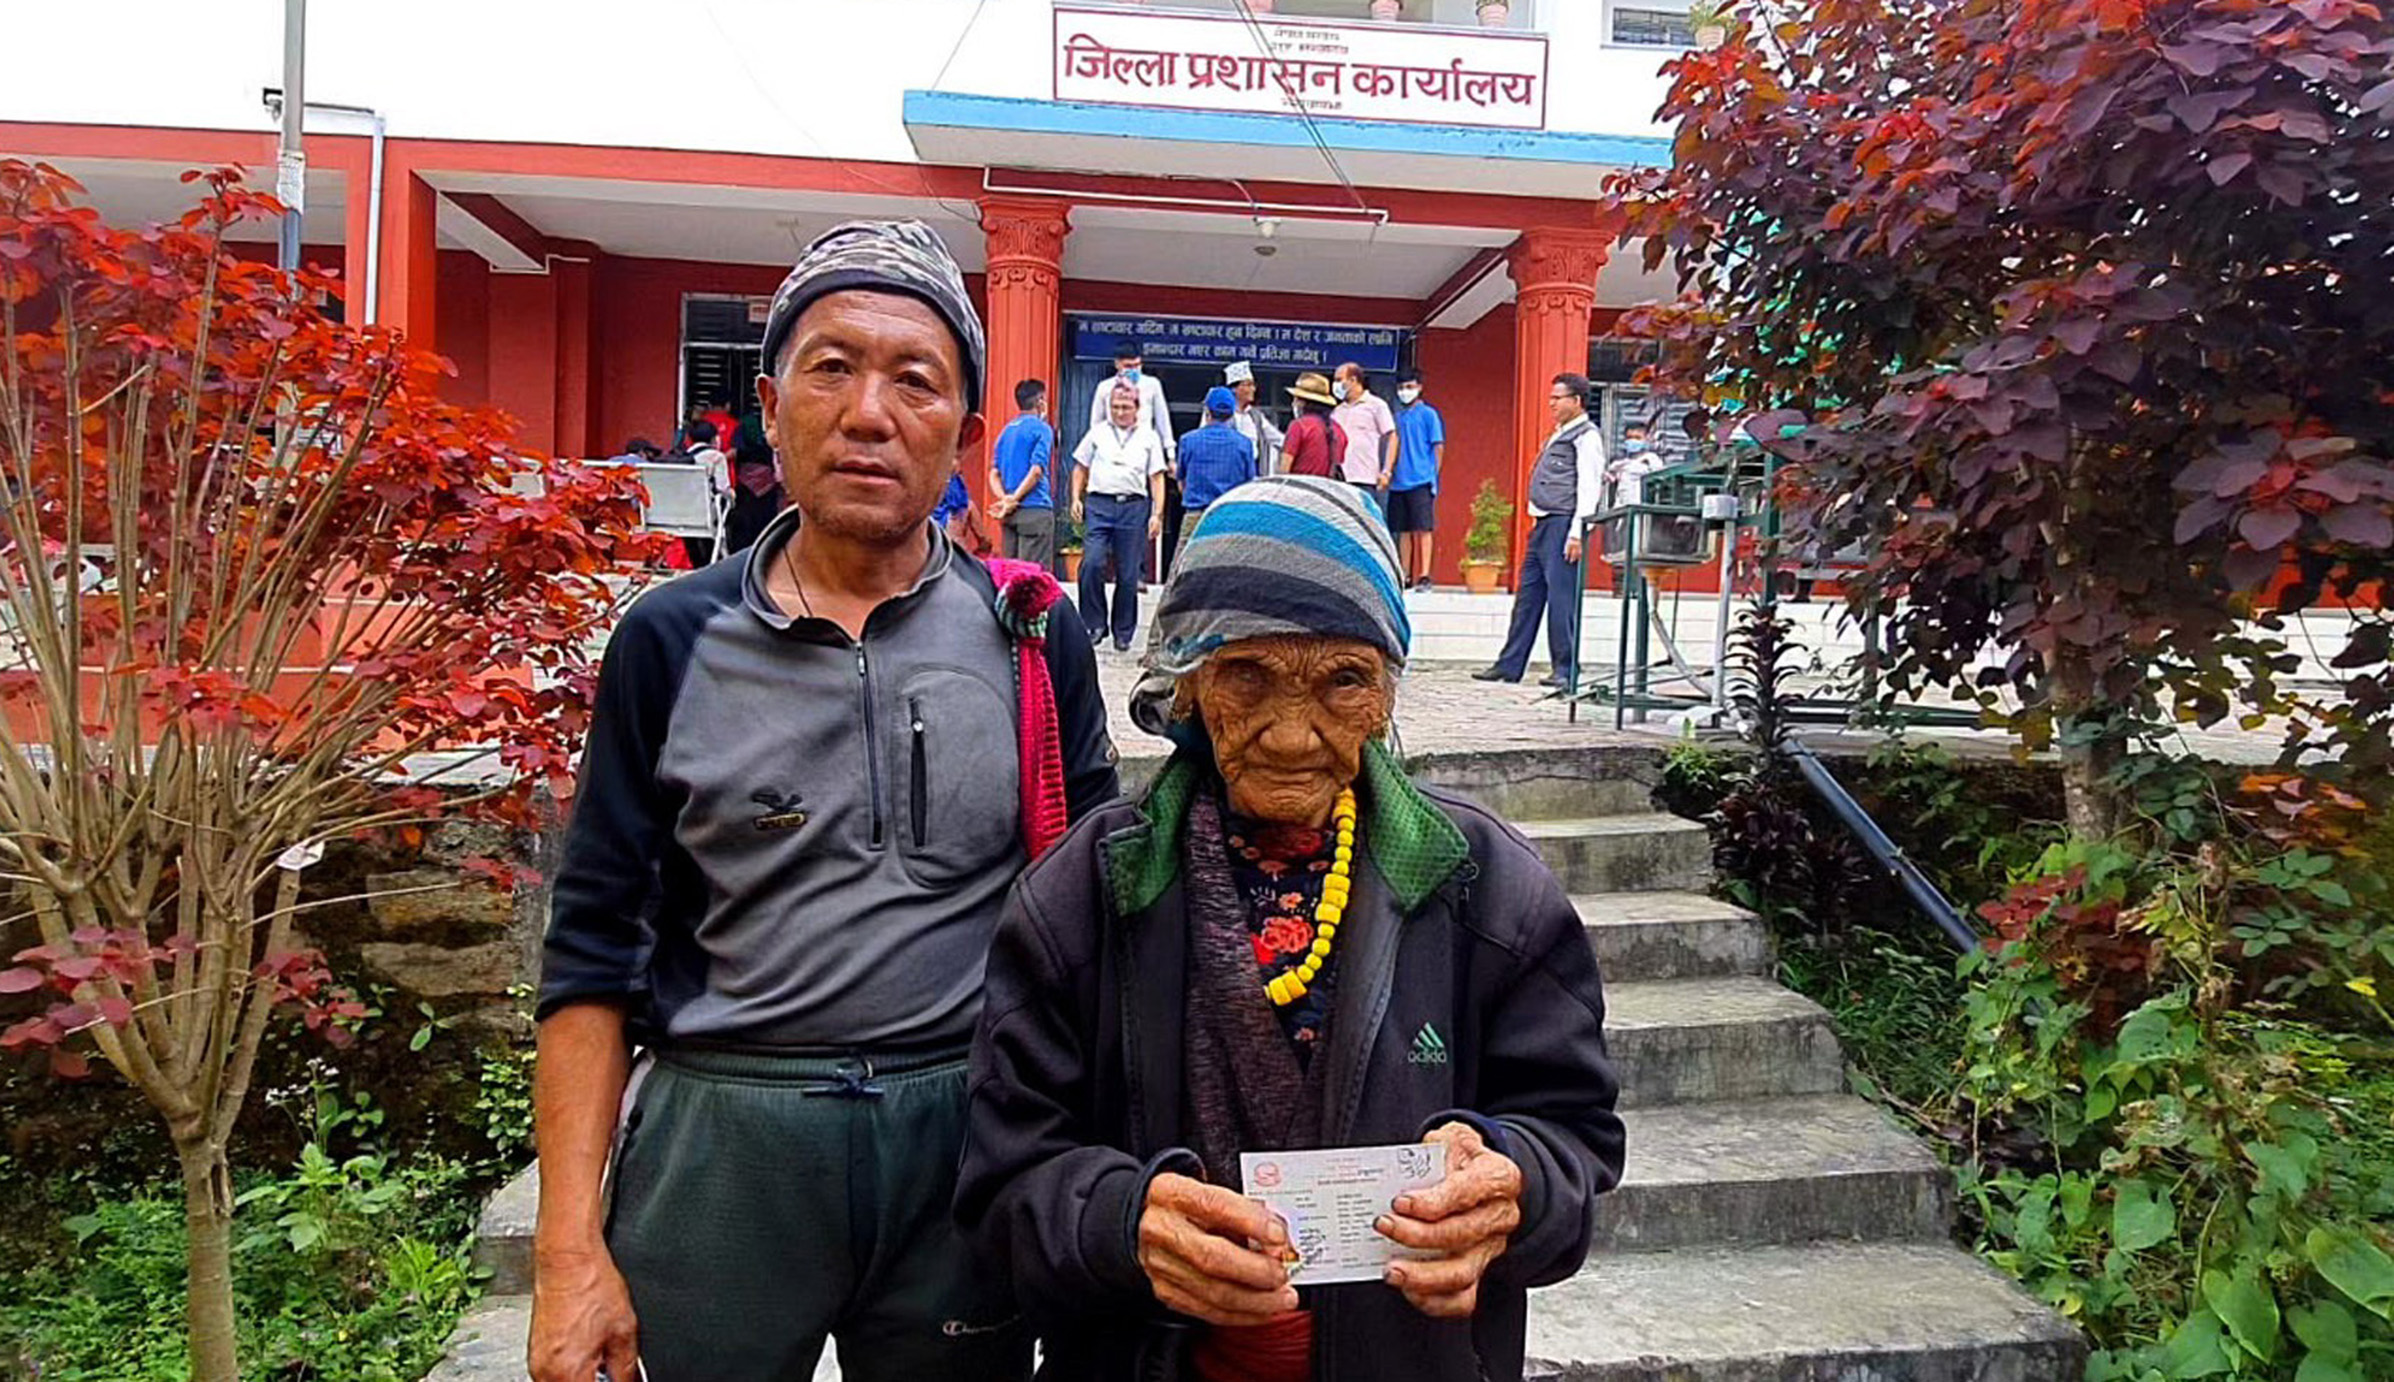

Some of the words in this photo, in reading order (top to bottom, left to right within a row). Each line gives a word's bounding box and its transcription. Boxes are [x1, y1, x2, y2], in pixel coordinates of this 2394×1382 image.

[1063, 33, 1179, 87] जिल्ला
[1185, 52, 1346, 96] प्रशासन
[1350, 58, 1536, 107] कार्यालय
